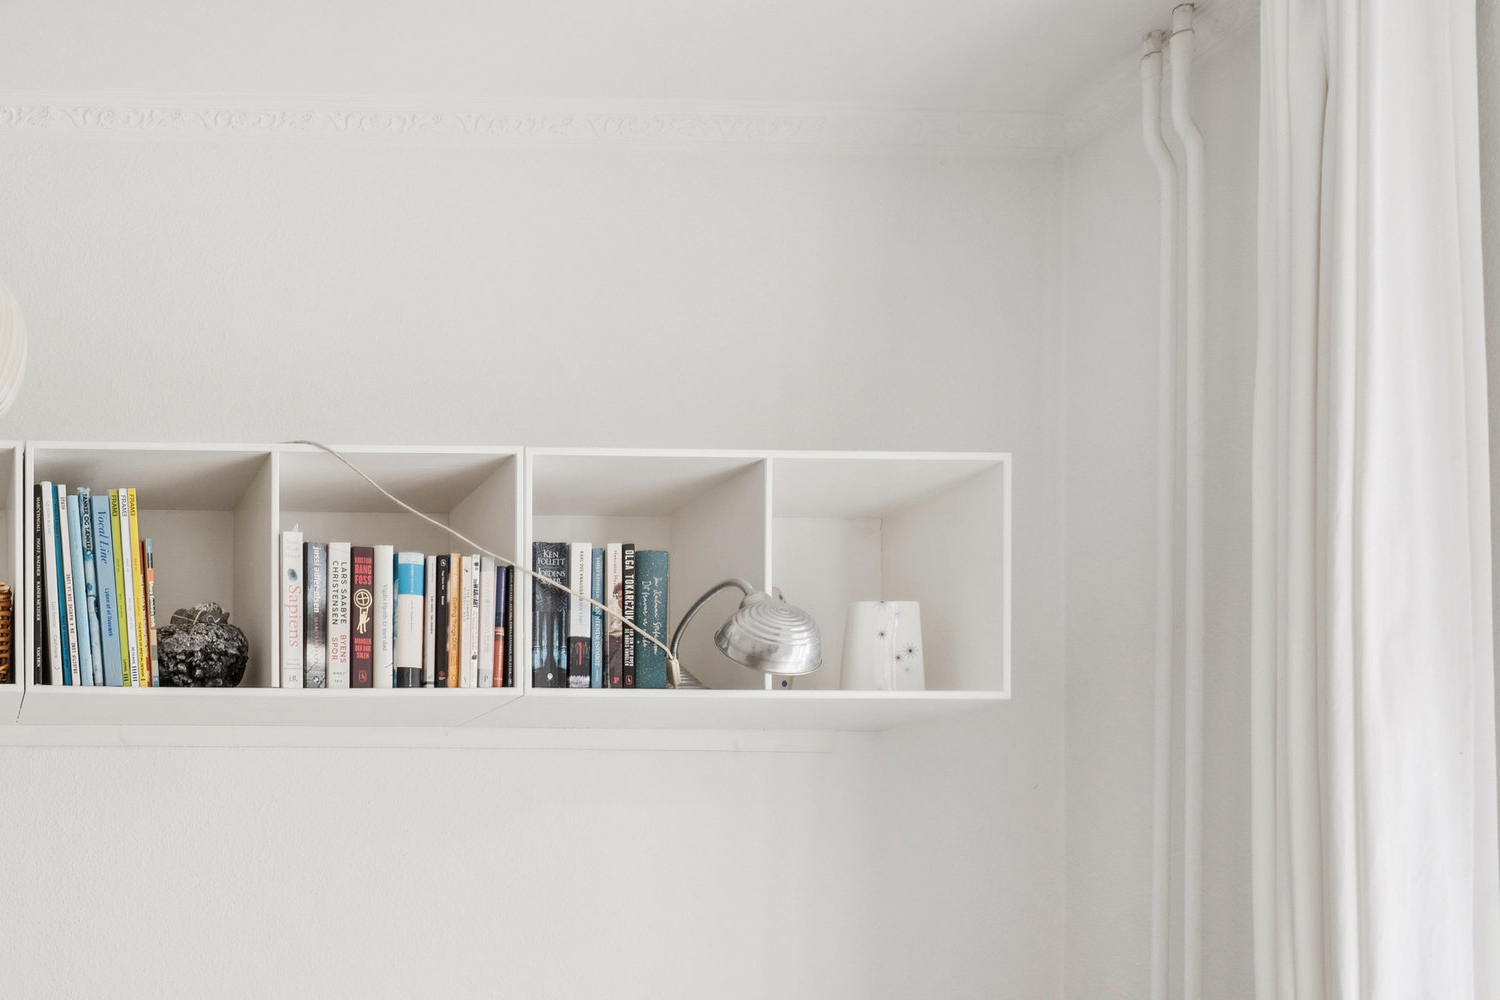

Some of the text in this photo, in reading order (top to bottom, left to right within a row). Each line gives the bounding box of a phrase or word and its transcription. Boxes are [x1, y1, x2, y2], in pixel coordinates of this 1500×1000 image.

[84, 516, 90, 525] OG
[97, 510, 110, 564] Vocal Line
[543, 549, 559, 558] KEN
[537, 557, 566, 566] FOLLETT
[354, 564, 372, 575] BANG
[538, 567, 566, 577] JORDENS
[312, 546, 321, 613] jussi adler-olsen
[354, 575, 372, 585] FOSS
[625, 549, 634, 621] OLGA TOKARCZUK
[104, 588, 112, 602] Lyden
[284, 584, 301, 647] Sapiens
